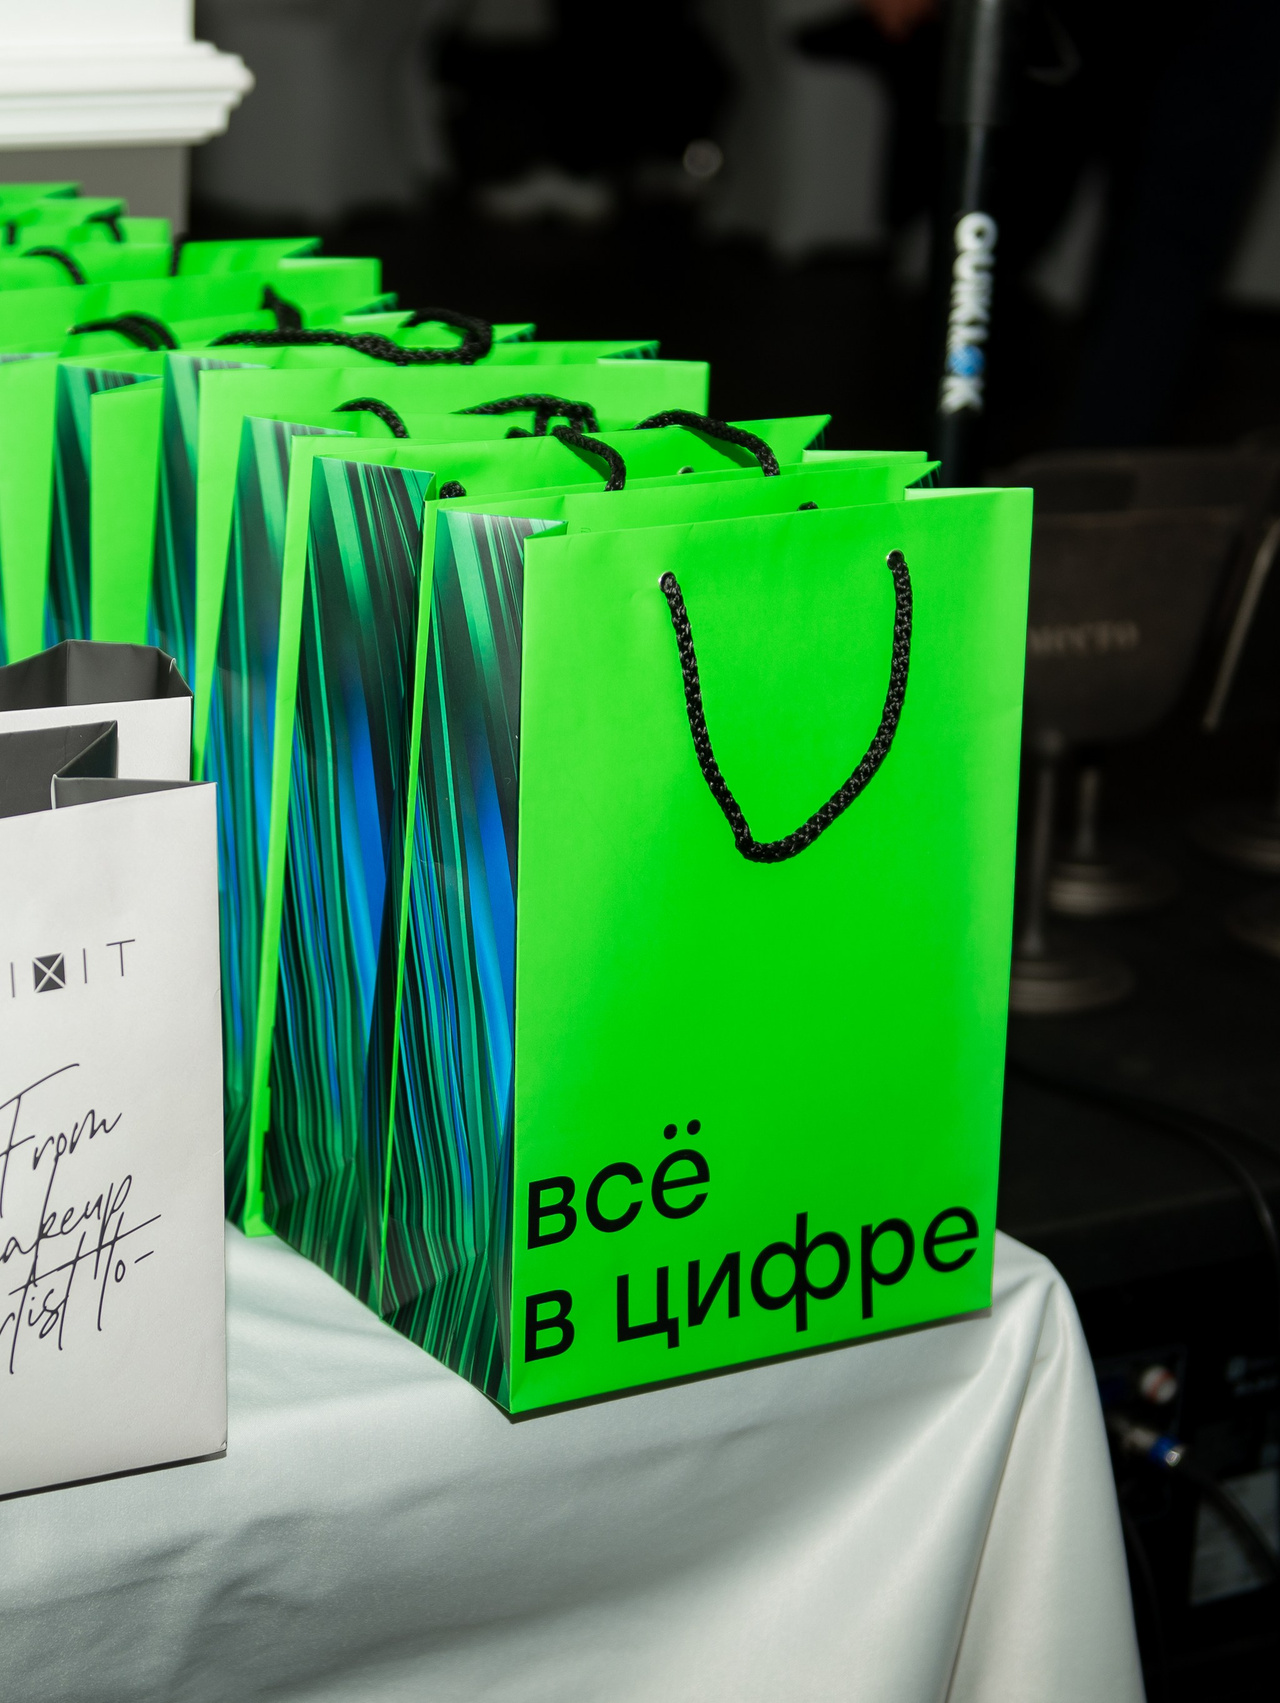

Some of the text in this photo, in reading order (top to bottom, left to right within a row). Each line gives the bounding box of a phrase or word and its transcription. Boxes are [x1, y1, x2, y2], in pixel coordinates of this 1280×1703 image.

[526, 1118, 711, 1251] всё
[523, 1205, 980, 1364] в цифре
